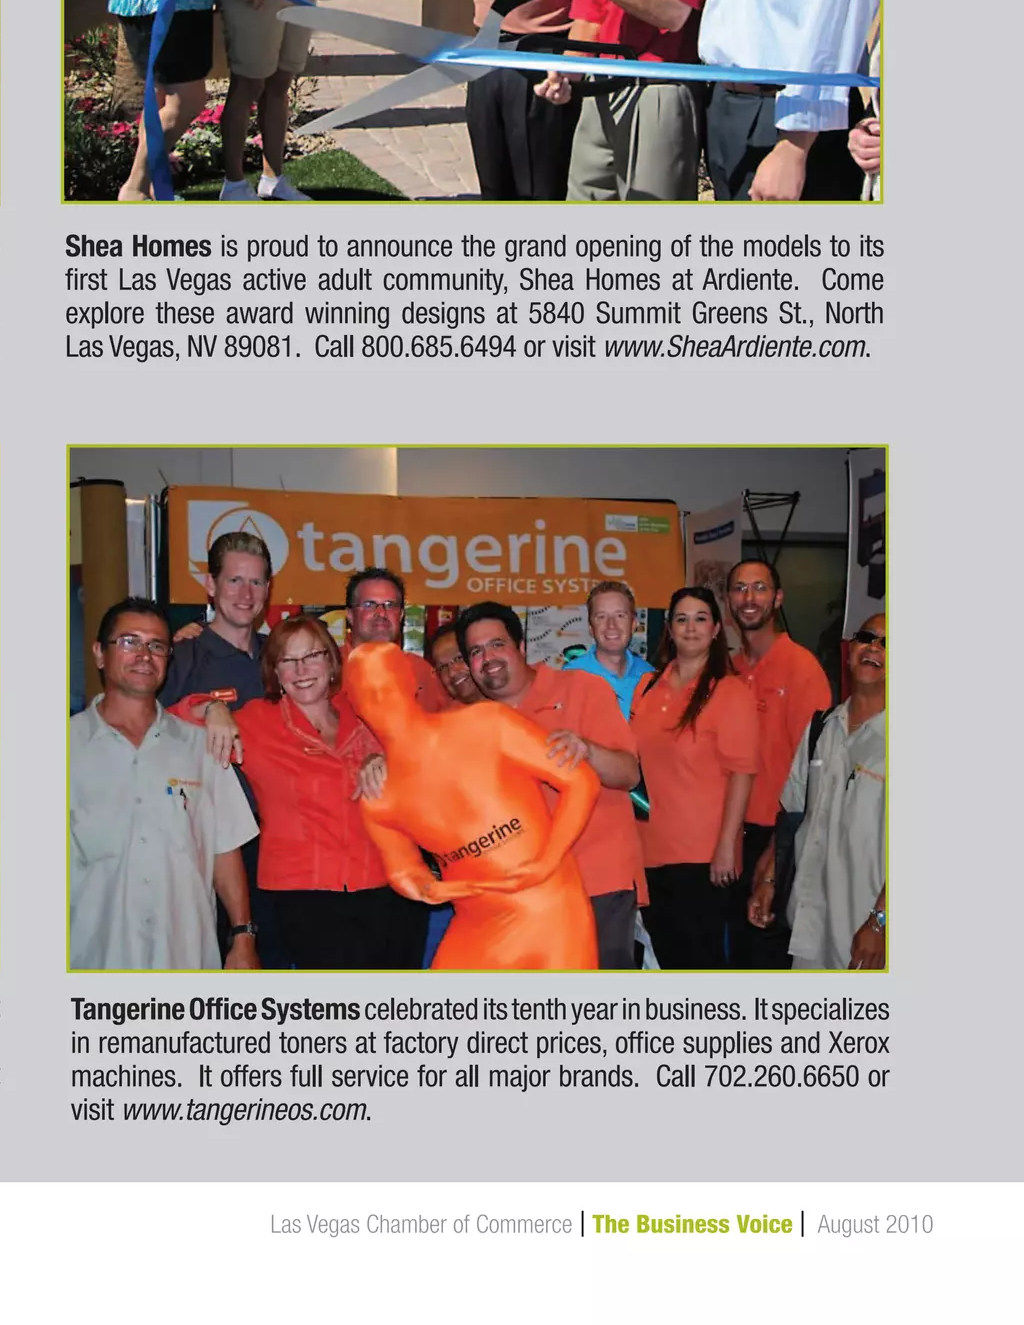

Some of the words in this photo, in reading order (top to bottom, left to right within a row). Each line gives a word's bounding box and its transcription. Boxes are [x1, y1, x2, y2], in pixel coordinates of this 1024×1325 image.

[65, 233, 123, 258] Shea
[132, 234, 212, 258] Homes
[221, 234, 239, 258] is
[247, 234, 309, 263] proud
[316, 234, 339, 258] to
[346, 239, 453, 258] announce
[460, 234, 496, 258] the
[504, 234, 567, 263] grand
[575, 234, 662, 263] opening
[670, 233, 692, 258] of
[698, 234, 734, 258] the
[743, 233, 822, 258] models
[829, 234, 851, 258] to
[859, 234, 885, 258] its
[66, 334, 104, 358] Las
[108, 334, 180, 363] Vegas,
[187, 334, 218, 358] NV
[224, 334, 301, 358] 89081.
[314, 334, 354, 358] Call
[361, 334, 517, 358] 800.685.6494
[523, 340, 547, 358] or
[551, 334, 597, 358] visit
[605, 334, 871, 358] www.SheaArdiente.com.
[297, 519, 627, 589] tangerine
[467, 577, 536, 594] OFFICE
[444, 817, 522, 863] tangerine
[70, 997, 186, 1026] Tangerine
[189, 996, 258, 1021] Office
[260, 996, 361, 1026] Systems
[364, 997, 478, 1021] celebrated
[483, 997, 509, 1021] its
[510, 997, 567, 1021] tenth
[570, 1002, 619, 1026] year
[622, 997, 641, 1021] in
[645, 997, 747, 1021] business.
[754, 997, 769, 1021] It
[771, 997, 890, 1026] specializes
[70, 1097, 115, 1121] visit
[123, 1097, 371, 1127] www.tangerineos.com.
[271, 1214, 302, 1234] Las
[306, 1214, 360, 1238] Vegas
[366, 1213, 448, 1234] Chamber
[453, 1213, 471, 1234] of
[476, 1213, 573, 1234] Commerce
[591, 1213, 631, 1235] The
[635, 1213, 731, 1235] Business
[735, 1213, 794, 1235] Voice
[817, 1214, 880, 1238] August
[886, 1214, 934, 1234] 2010
